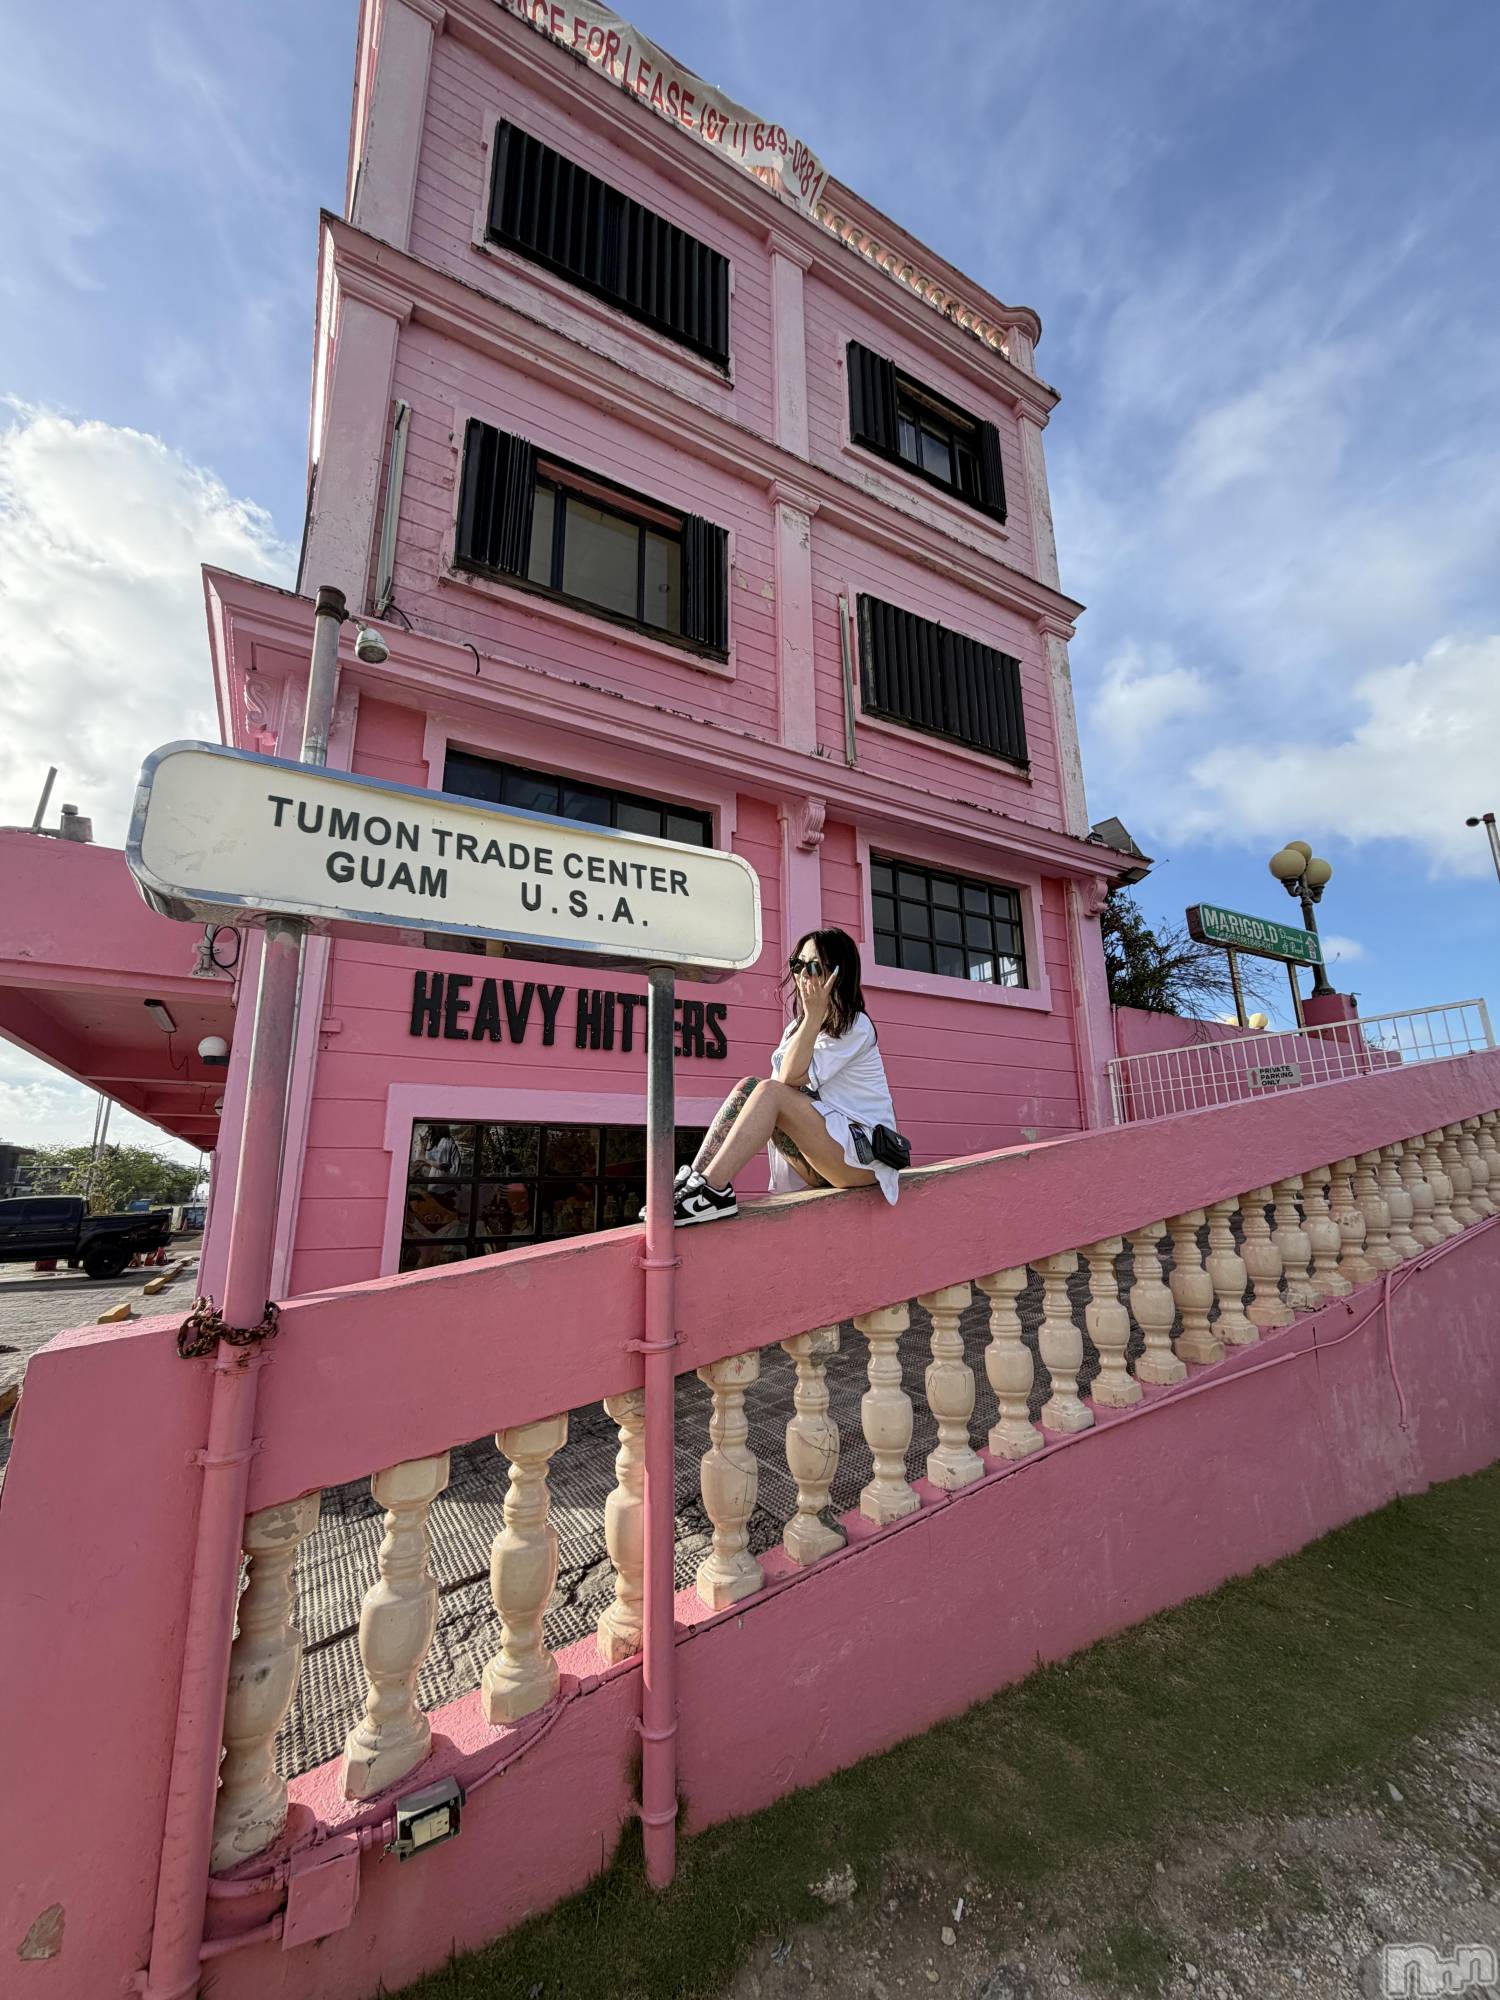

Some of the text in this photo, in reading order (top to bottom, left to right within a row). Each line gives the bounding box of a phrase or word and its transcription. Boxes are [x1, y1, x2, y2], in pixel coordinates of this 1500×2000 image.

[571, 16, 620, 78] FOR
[622, 44, 695, 126] LEASE
[267, 795, 690, 897] TUMON TRADE CENTER
[326, 851, 649, 927] GUAM U.S.A.
[1204, 908, 1279, 944] MARIGOLD
[410, 970, 728, 1060] HEAVY HITRS
[1260, 1065, 1291, 1074] PRIVATE
[1260, 1071, 1294, 1081] PARKING
